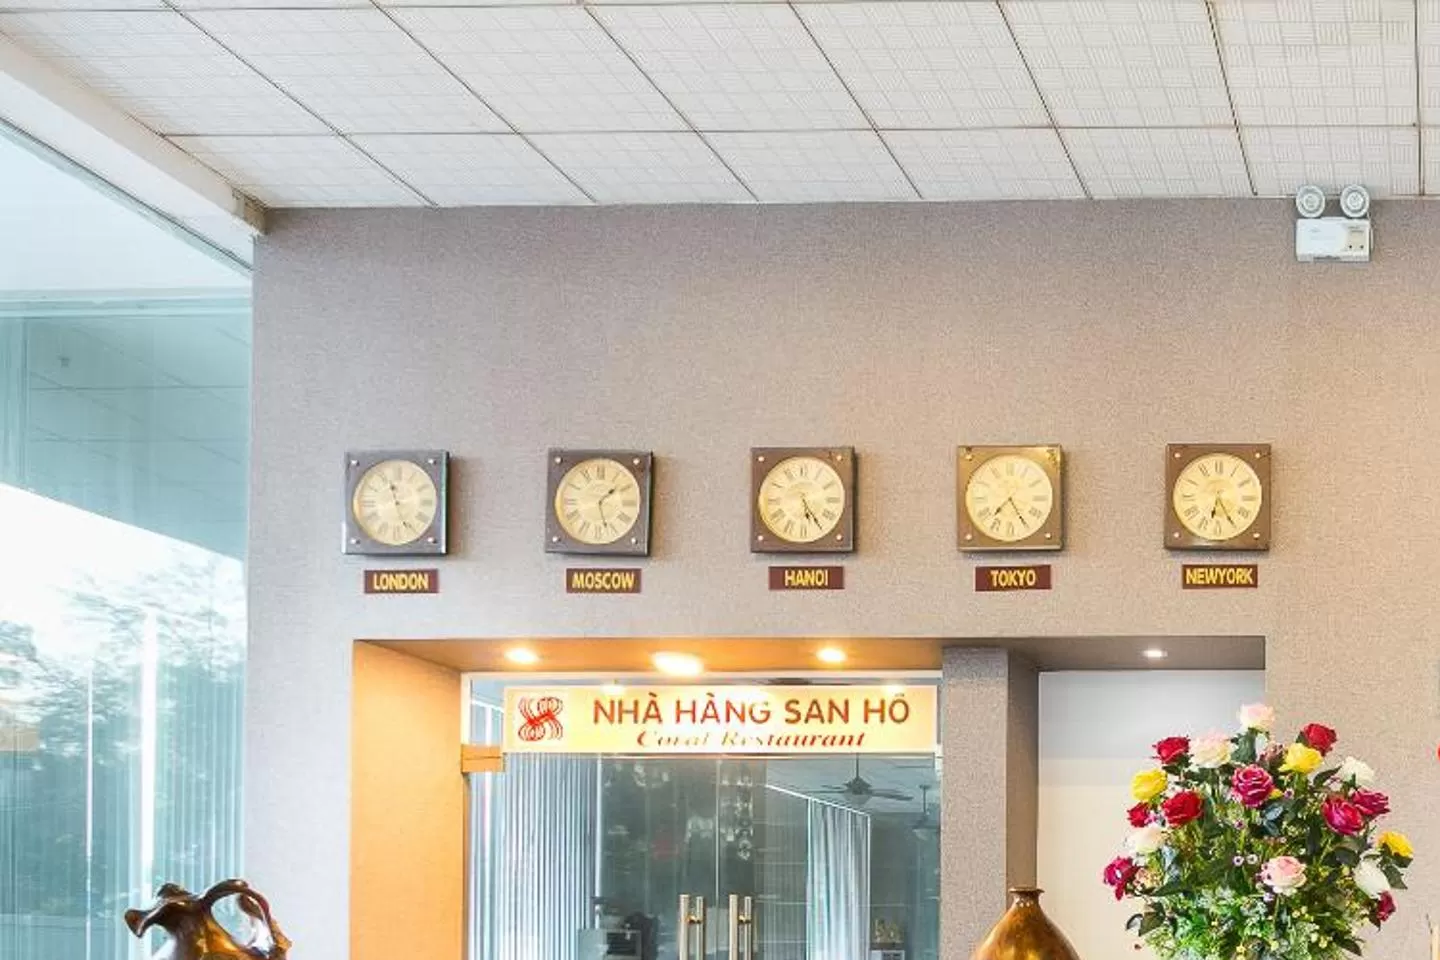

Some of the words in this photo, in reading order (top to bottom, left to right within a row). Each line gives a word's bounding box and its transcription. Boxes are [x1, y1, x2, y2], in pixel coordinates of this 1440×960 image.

[373, 571, 429, 590] LONDON
[572, 571, 635, 590] MOSCOW
[785, 569, 829, 588] HANOI
[990, 569, 1037, 587] TOKYO
[1185, 567, 1254, 586] NEWYORK
[592, 691, 664, 725] NHÀ
[674, 691, 772, 725] HÀNG
[783, 698, 851, 725] SAN
[862, 692, 911, 725] HÔ
